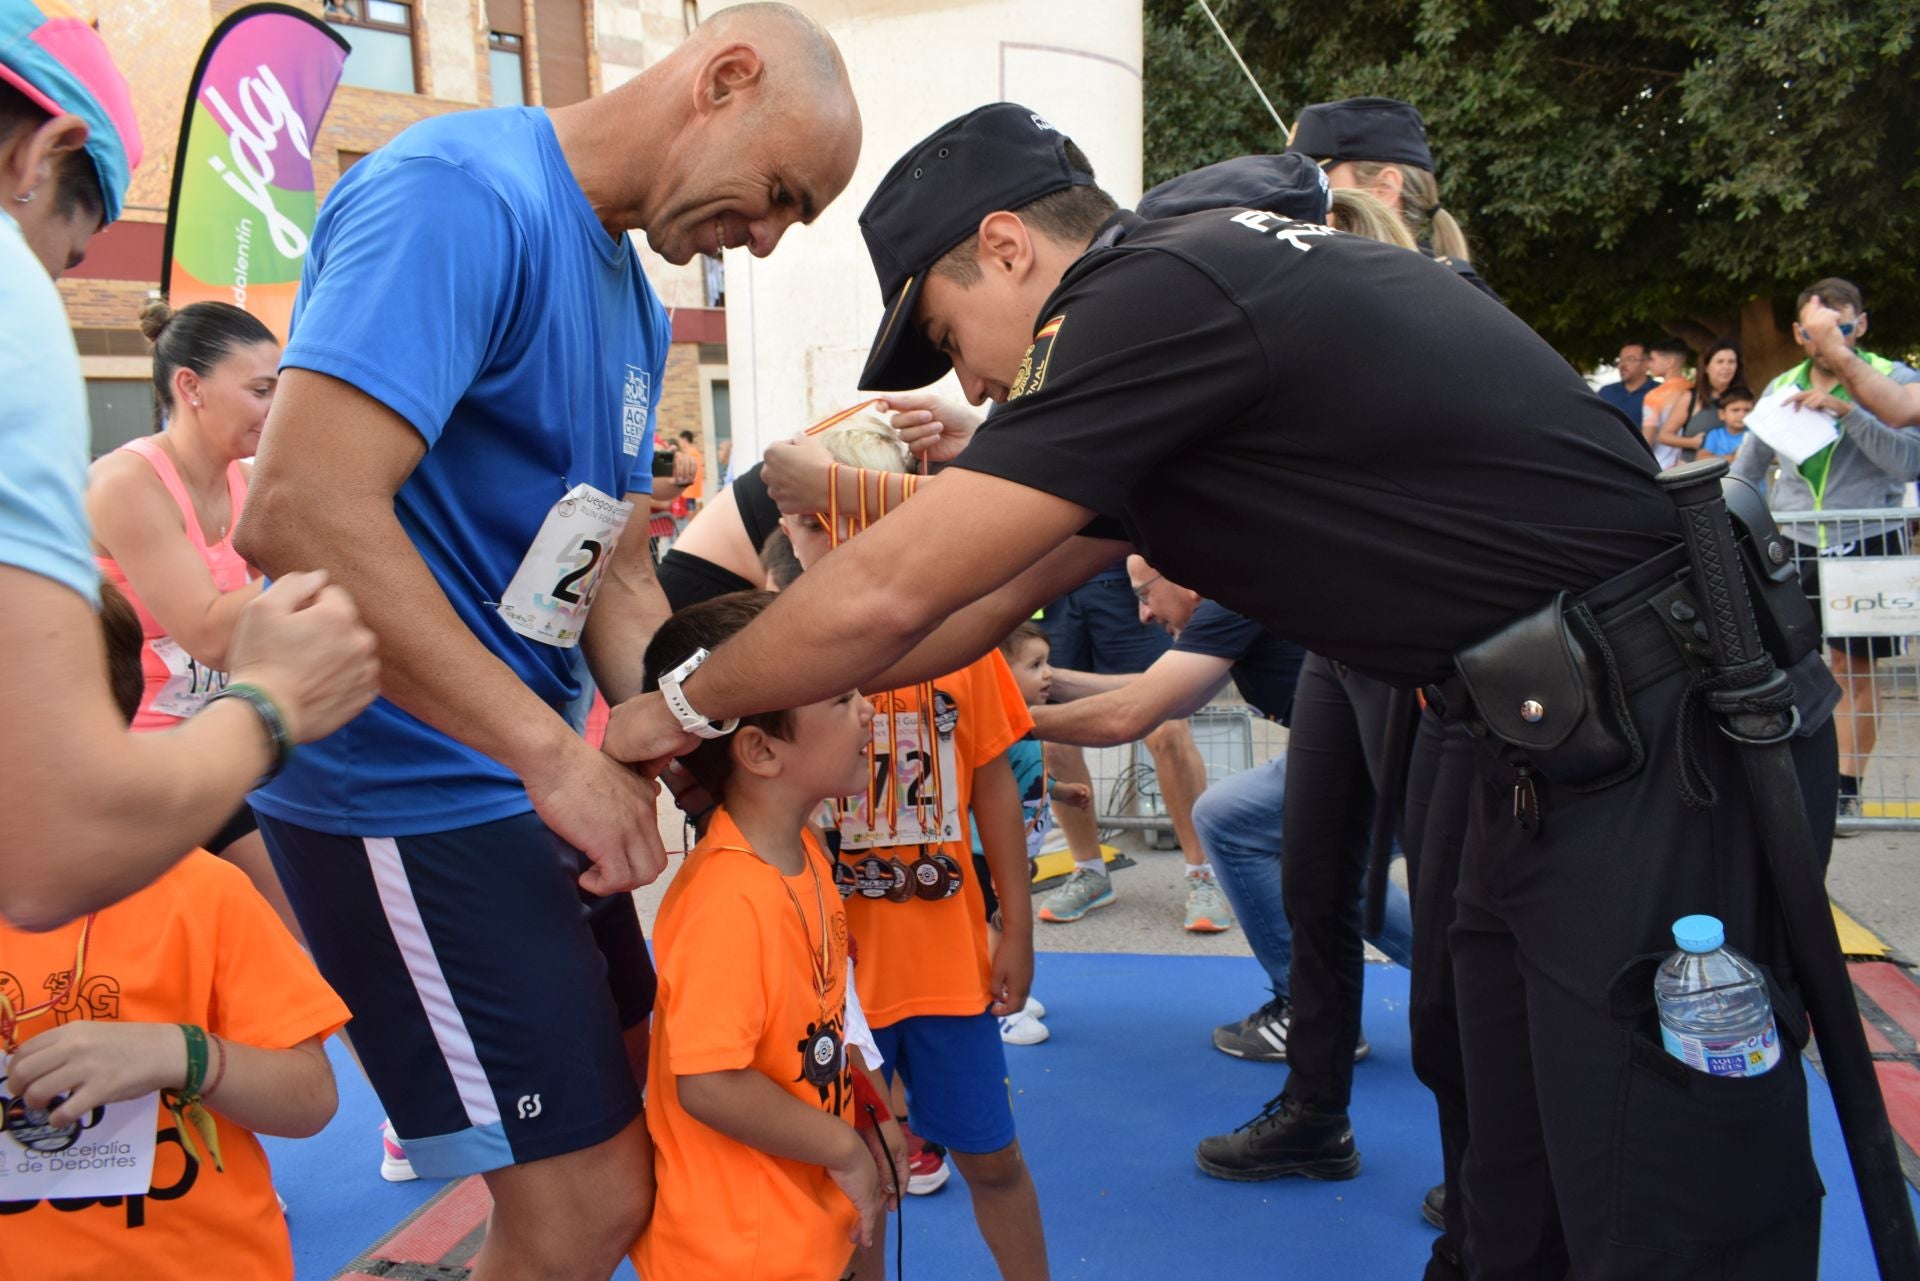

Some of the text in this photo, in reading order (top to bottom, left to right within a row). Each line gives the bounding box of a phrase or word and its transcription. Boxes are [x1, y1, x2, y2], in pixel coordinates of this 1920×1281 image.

[1830, 592, 1914, 613] dpts
[17, 1159, 43, 1173] de
[50, 1154, 136, 1171] Deportes
